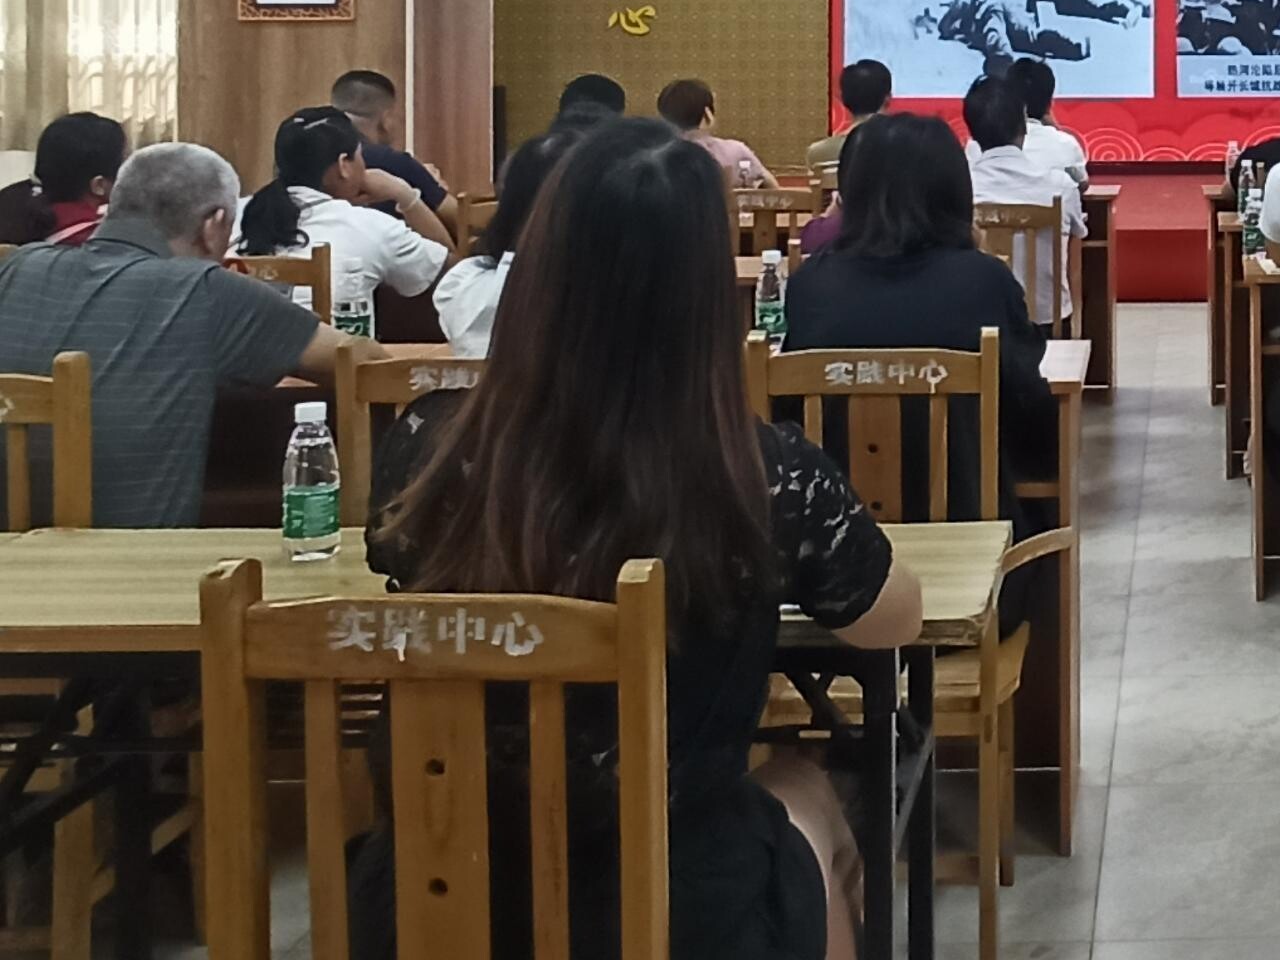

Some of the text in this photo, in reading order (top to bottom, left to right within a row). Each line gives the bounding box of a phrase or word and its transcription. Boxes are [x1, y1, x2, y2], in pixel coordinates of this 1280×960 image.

[824, 359, 950, 394] 实践中心
[326, 605, 545, 662] 实践中心
